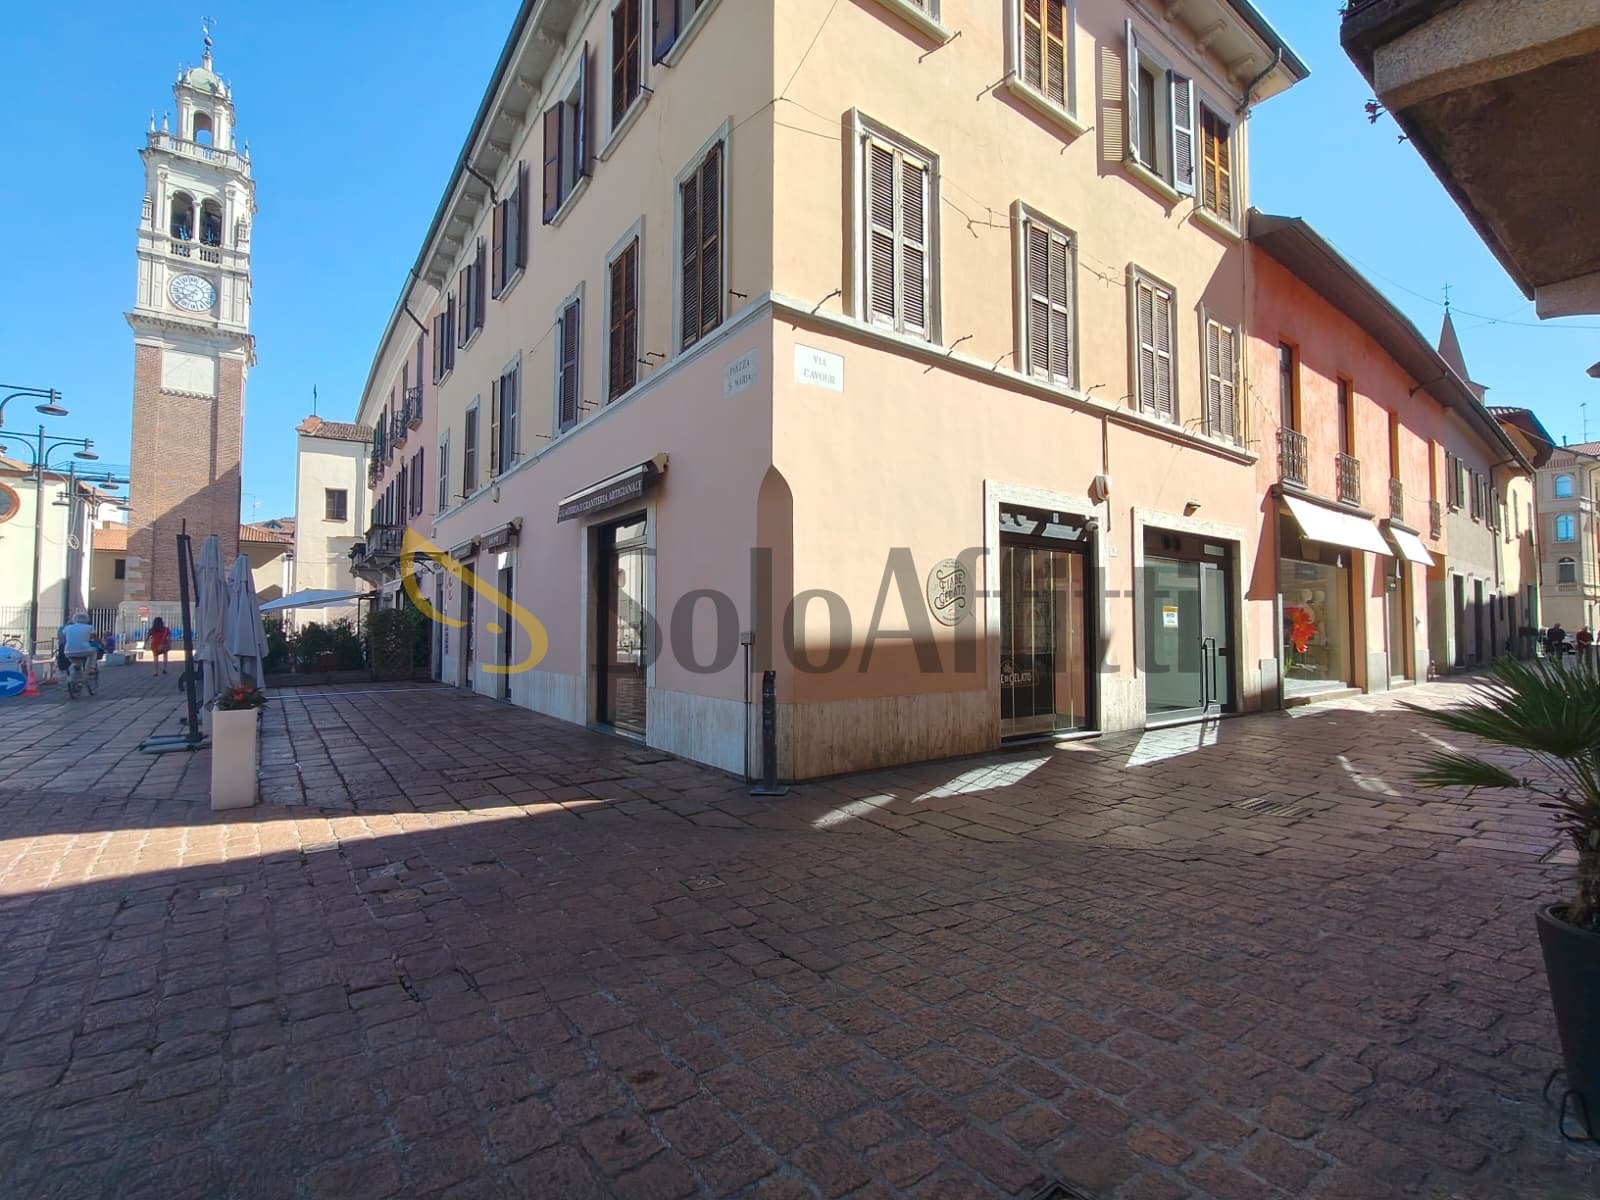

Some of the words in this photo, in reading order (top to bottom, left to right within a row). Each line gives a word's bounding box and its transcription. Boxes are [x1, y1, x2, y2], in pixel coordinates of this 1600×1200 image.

[729, 359, 752, 376] PIAZZA
[813, 354, 827, 367] VIA
[803, 367, 836, 385] CAVOUR
